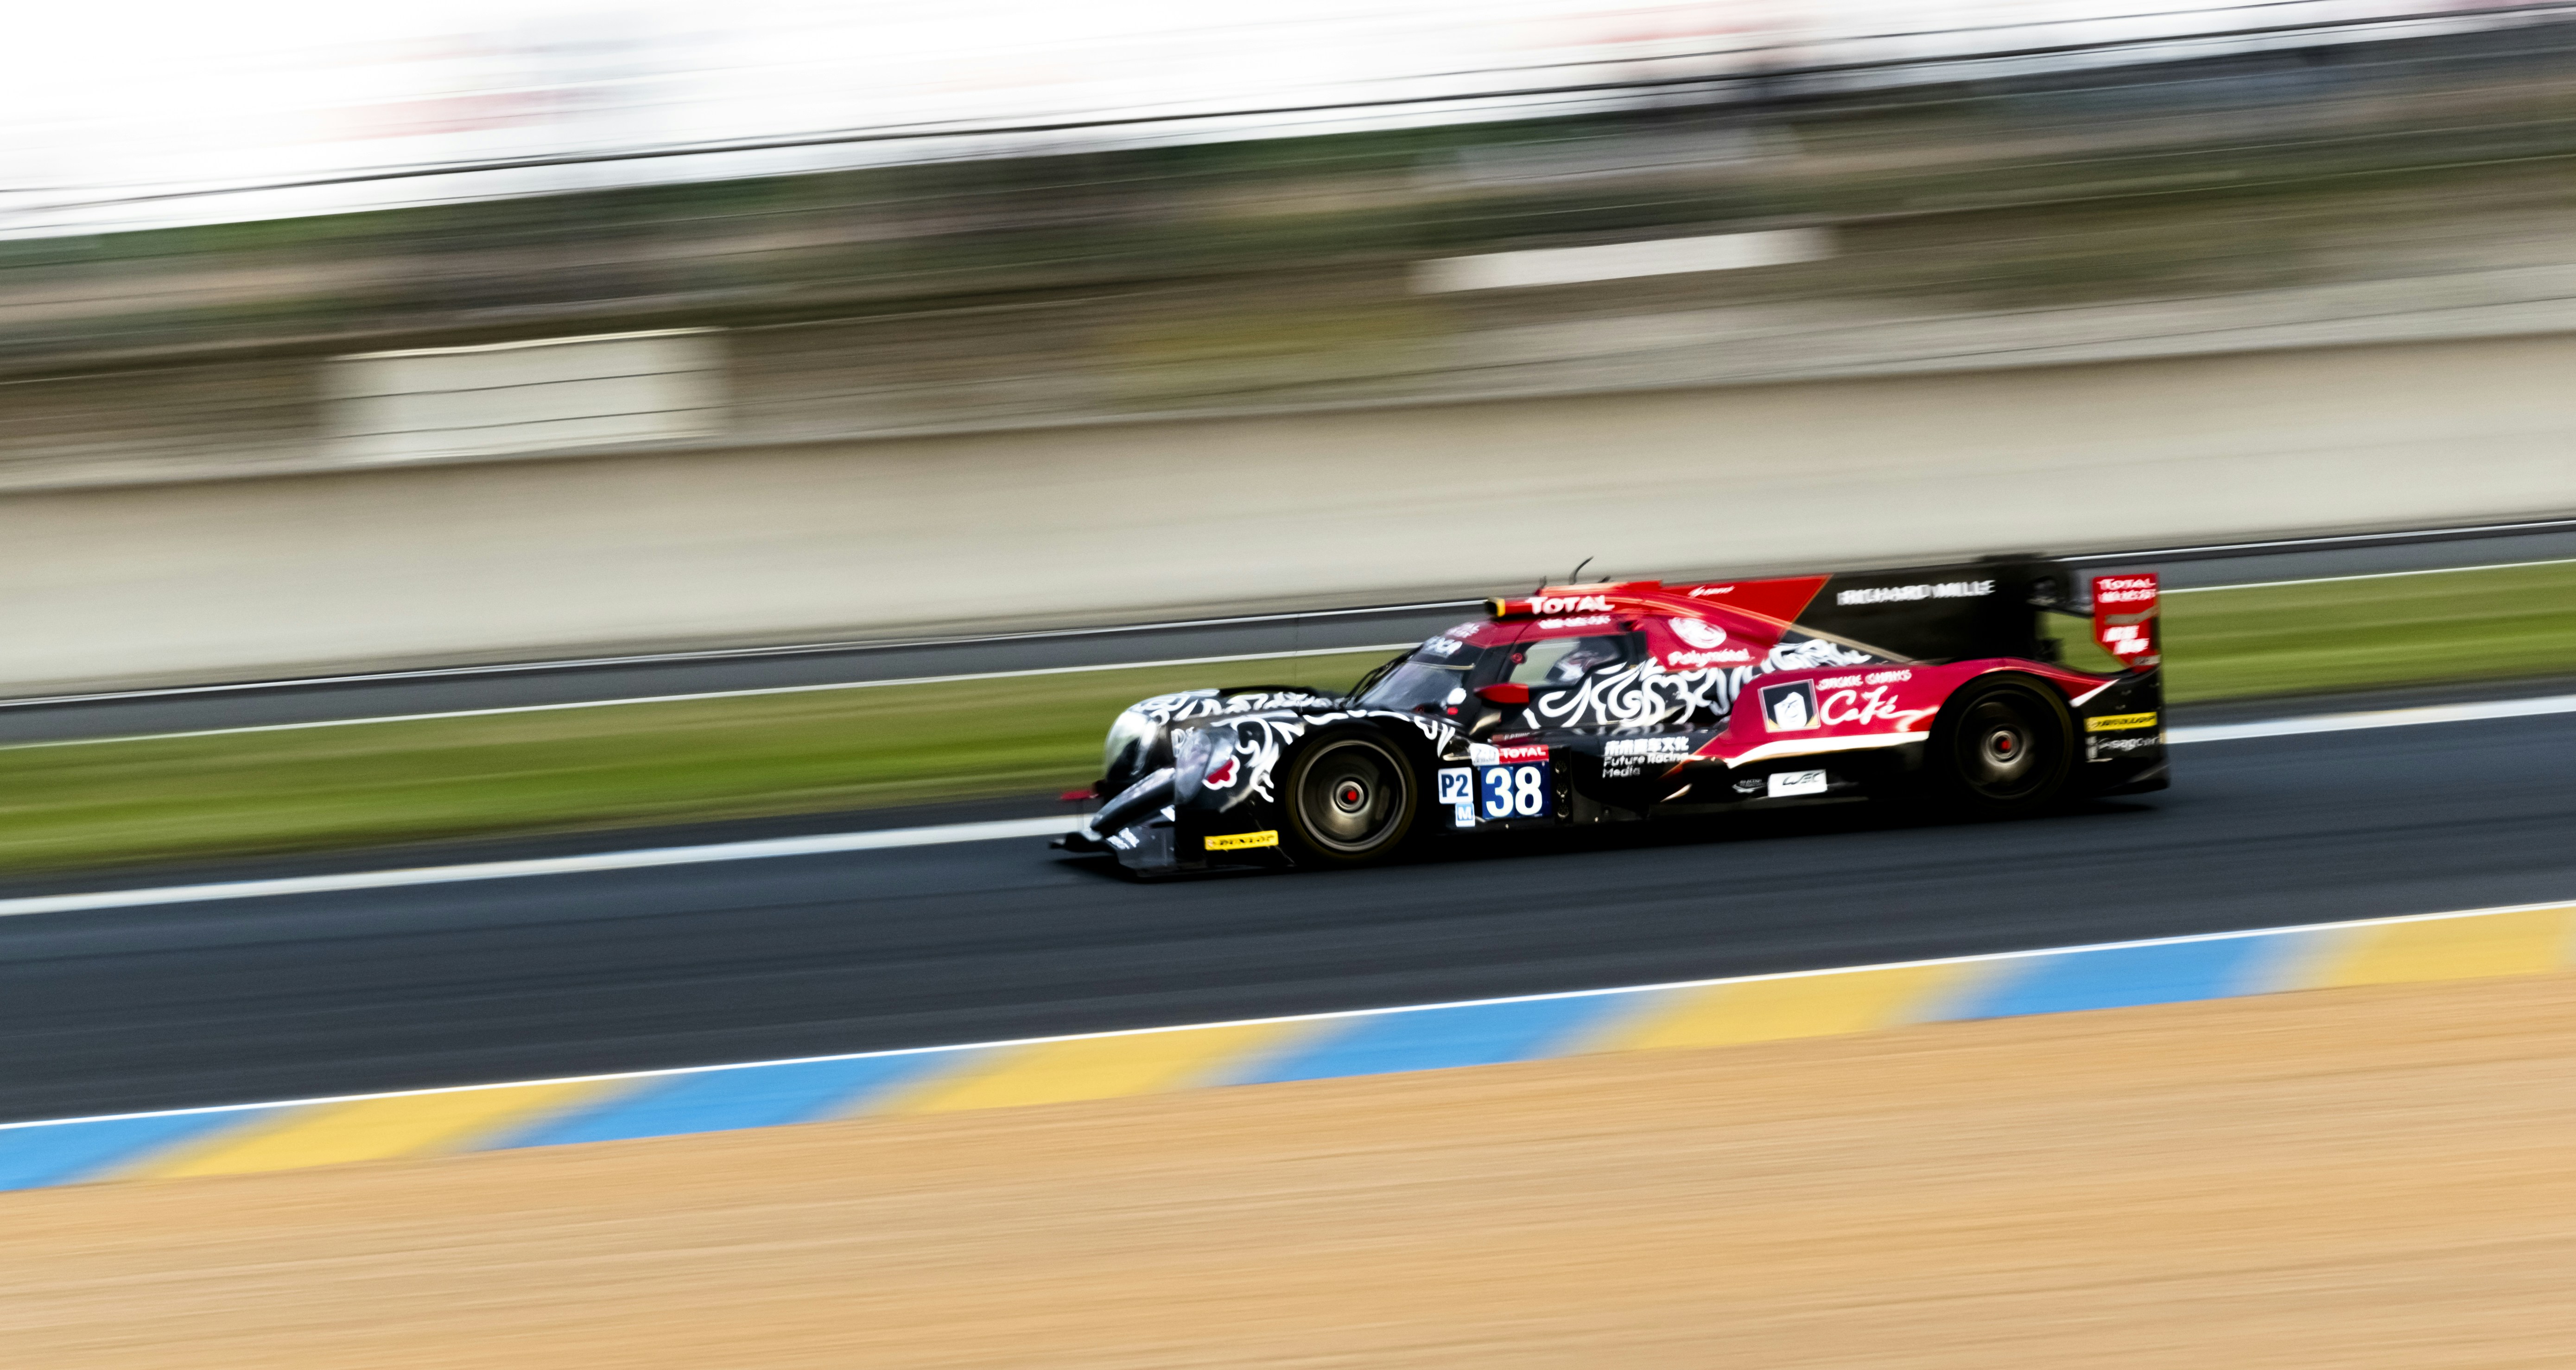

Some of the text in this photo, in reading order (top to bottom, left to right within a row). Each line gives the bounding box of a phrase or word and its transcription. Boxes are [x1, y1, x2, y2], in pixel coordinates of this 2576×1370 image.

[1837, 580, 1995, 605] RICHARD MILLE
[2097, 578, 2156, 591] TOTAL
[1525, 595, 1616, 615] TOTAL
[1815, 675, 1864, 691] JACKIE
[1820, 685, 1910, 725] Café
[1501, 746, 1546, 758] TOTAL
[1603, 751, 1689, 767] Future Racing
[1602, 765, 1641, 778] Media
[1441, 773, 1469, 797] P2
[1485, 766, 1542, 817] 38
